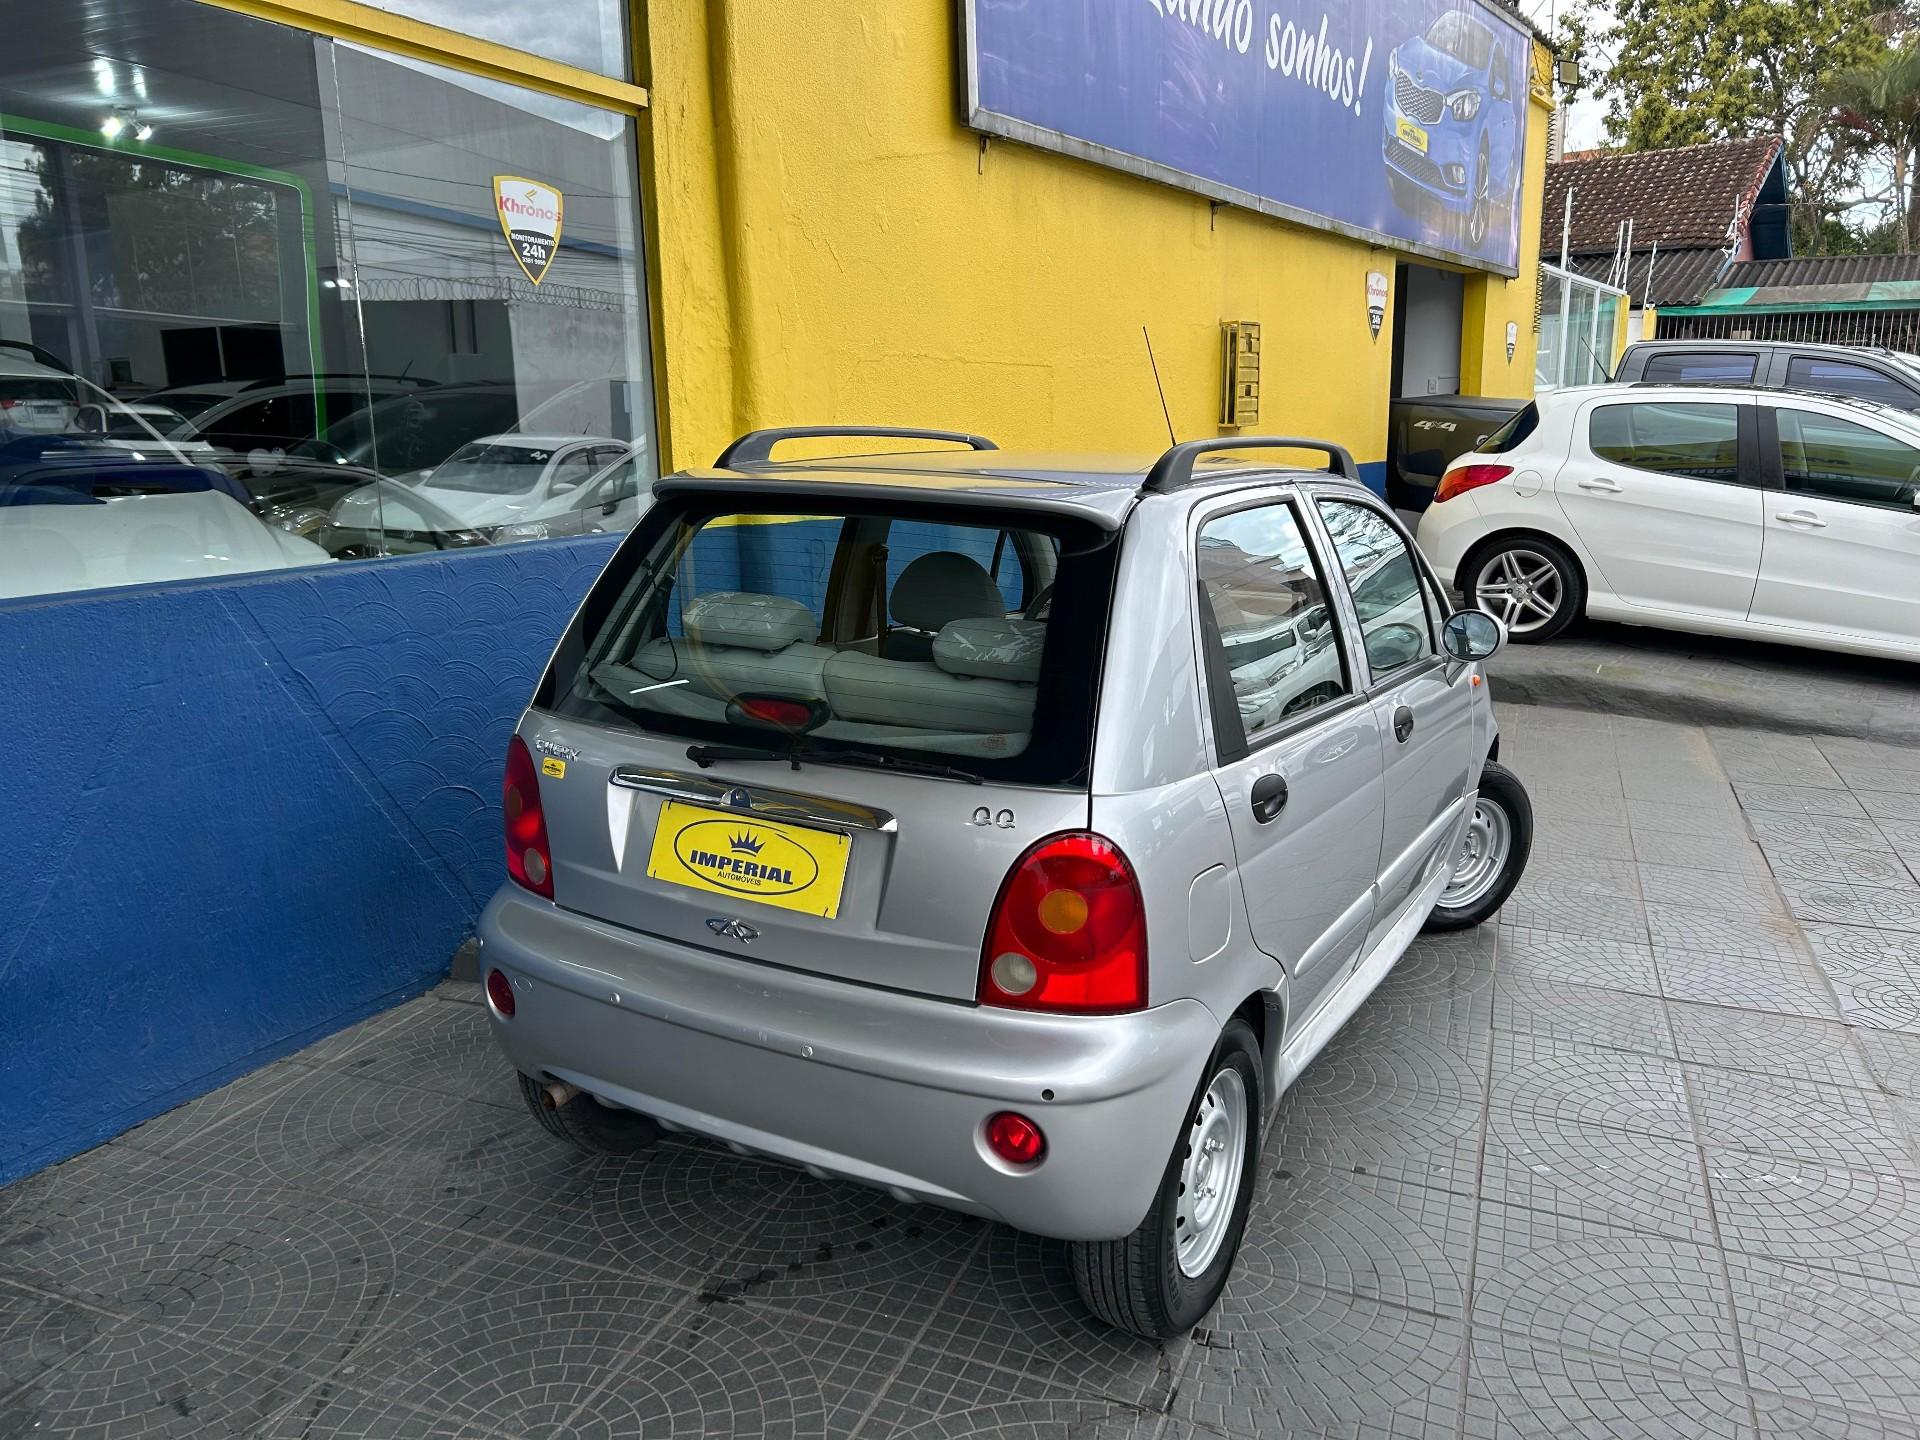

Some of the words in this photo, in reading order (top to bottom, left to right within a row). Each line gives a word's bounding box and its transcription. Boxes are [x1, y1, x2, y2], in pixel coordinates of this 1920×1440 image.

[1265, 12, 1373, 117] sonhos!
[500, 196, 562, 222] Khronos
[511, 232, 555, 247] MONITORAMENTO
[522, 243, 546, 259] 24h
[1367, 284, 1388, 297] Khronos
[973, 806, 1016, 829] QQ
[690, 849, 794, 885] IMPERIAL
[717, 870, 762, 886] AUTOMÓVEIS
